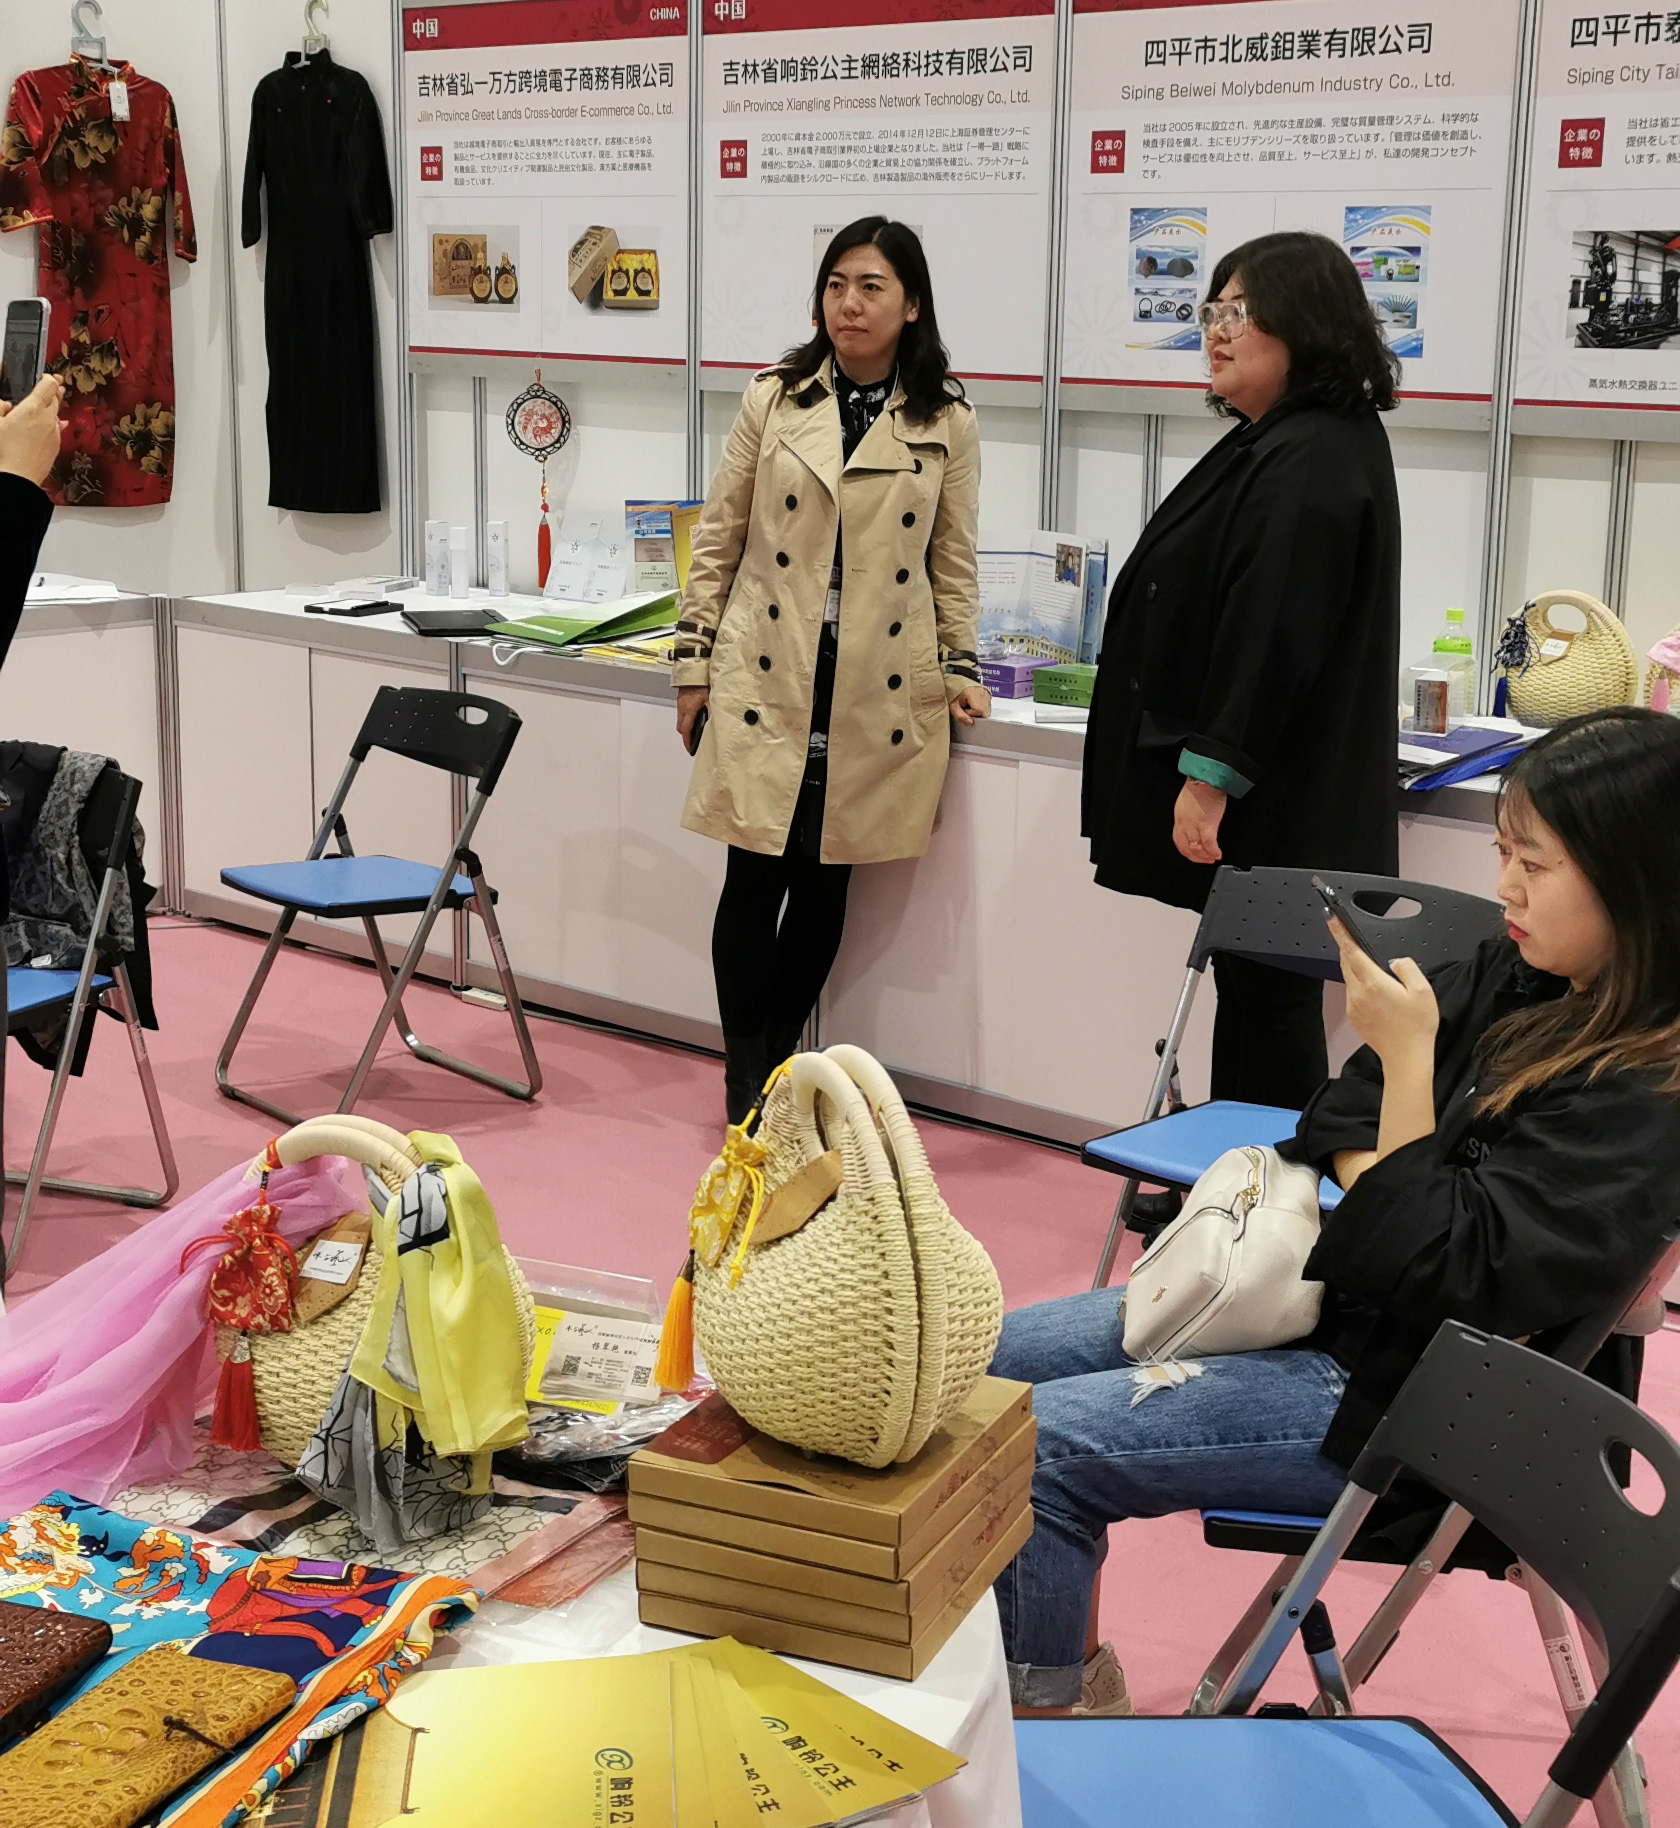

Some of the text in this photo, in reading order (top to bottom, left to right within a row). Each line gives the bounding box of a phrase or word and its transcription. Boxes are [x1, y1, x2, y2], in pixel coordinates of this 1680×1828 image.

[649, 6, 680, 21] CHINA
[714, 0, 746, 21] 中国
[412, 18, 438, 39] 中国
[1145, 22, 1433, 67] 四平市北威鉬業有限公司
[722, 45, 1033, 86] 吉林省响鈴公主網絡科技有限公司
[1567, 67, 1615, 86] Siping
[1619, 65, 1651, 83] City
[417, 62, 674, 98] 吉林省弘一万方跨境電子商務有限公司
[1121, 70, 1455, 101] Siping Beiwei Molybdenum Industry Co., Ltd.
[417, 101, 674, 122] Jilin Province Great Lands Cross-border E-commerce Co., Ltd.
[722, 89, 1031, 114] Jilin Province Xiangling Princess Network Technology Co., Ltd.
[1094, 139, 1123, 151] 企業の
[1564, 128, 1601, 143] 企業の
[1098, 154, 1118, 167] 特徴
[1568, 146, 1594, 161] 特徴
[1141, 169, 1162, 179] です。
[609, 1777, 635, 1828] 响铃公
